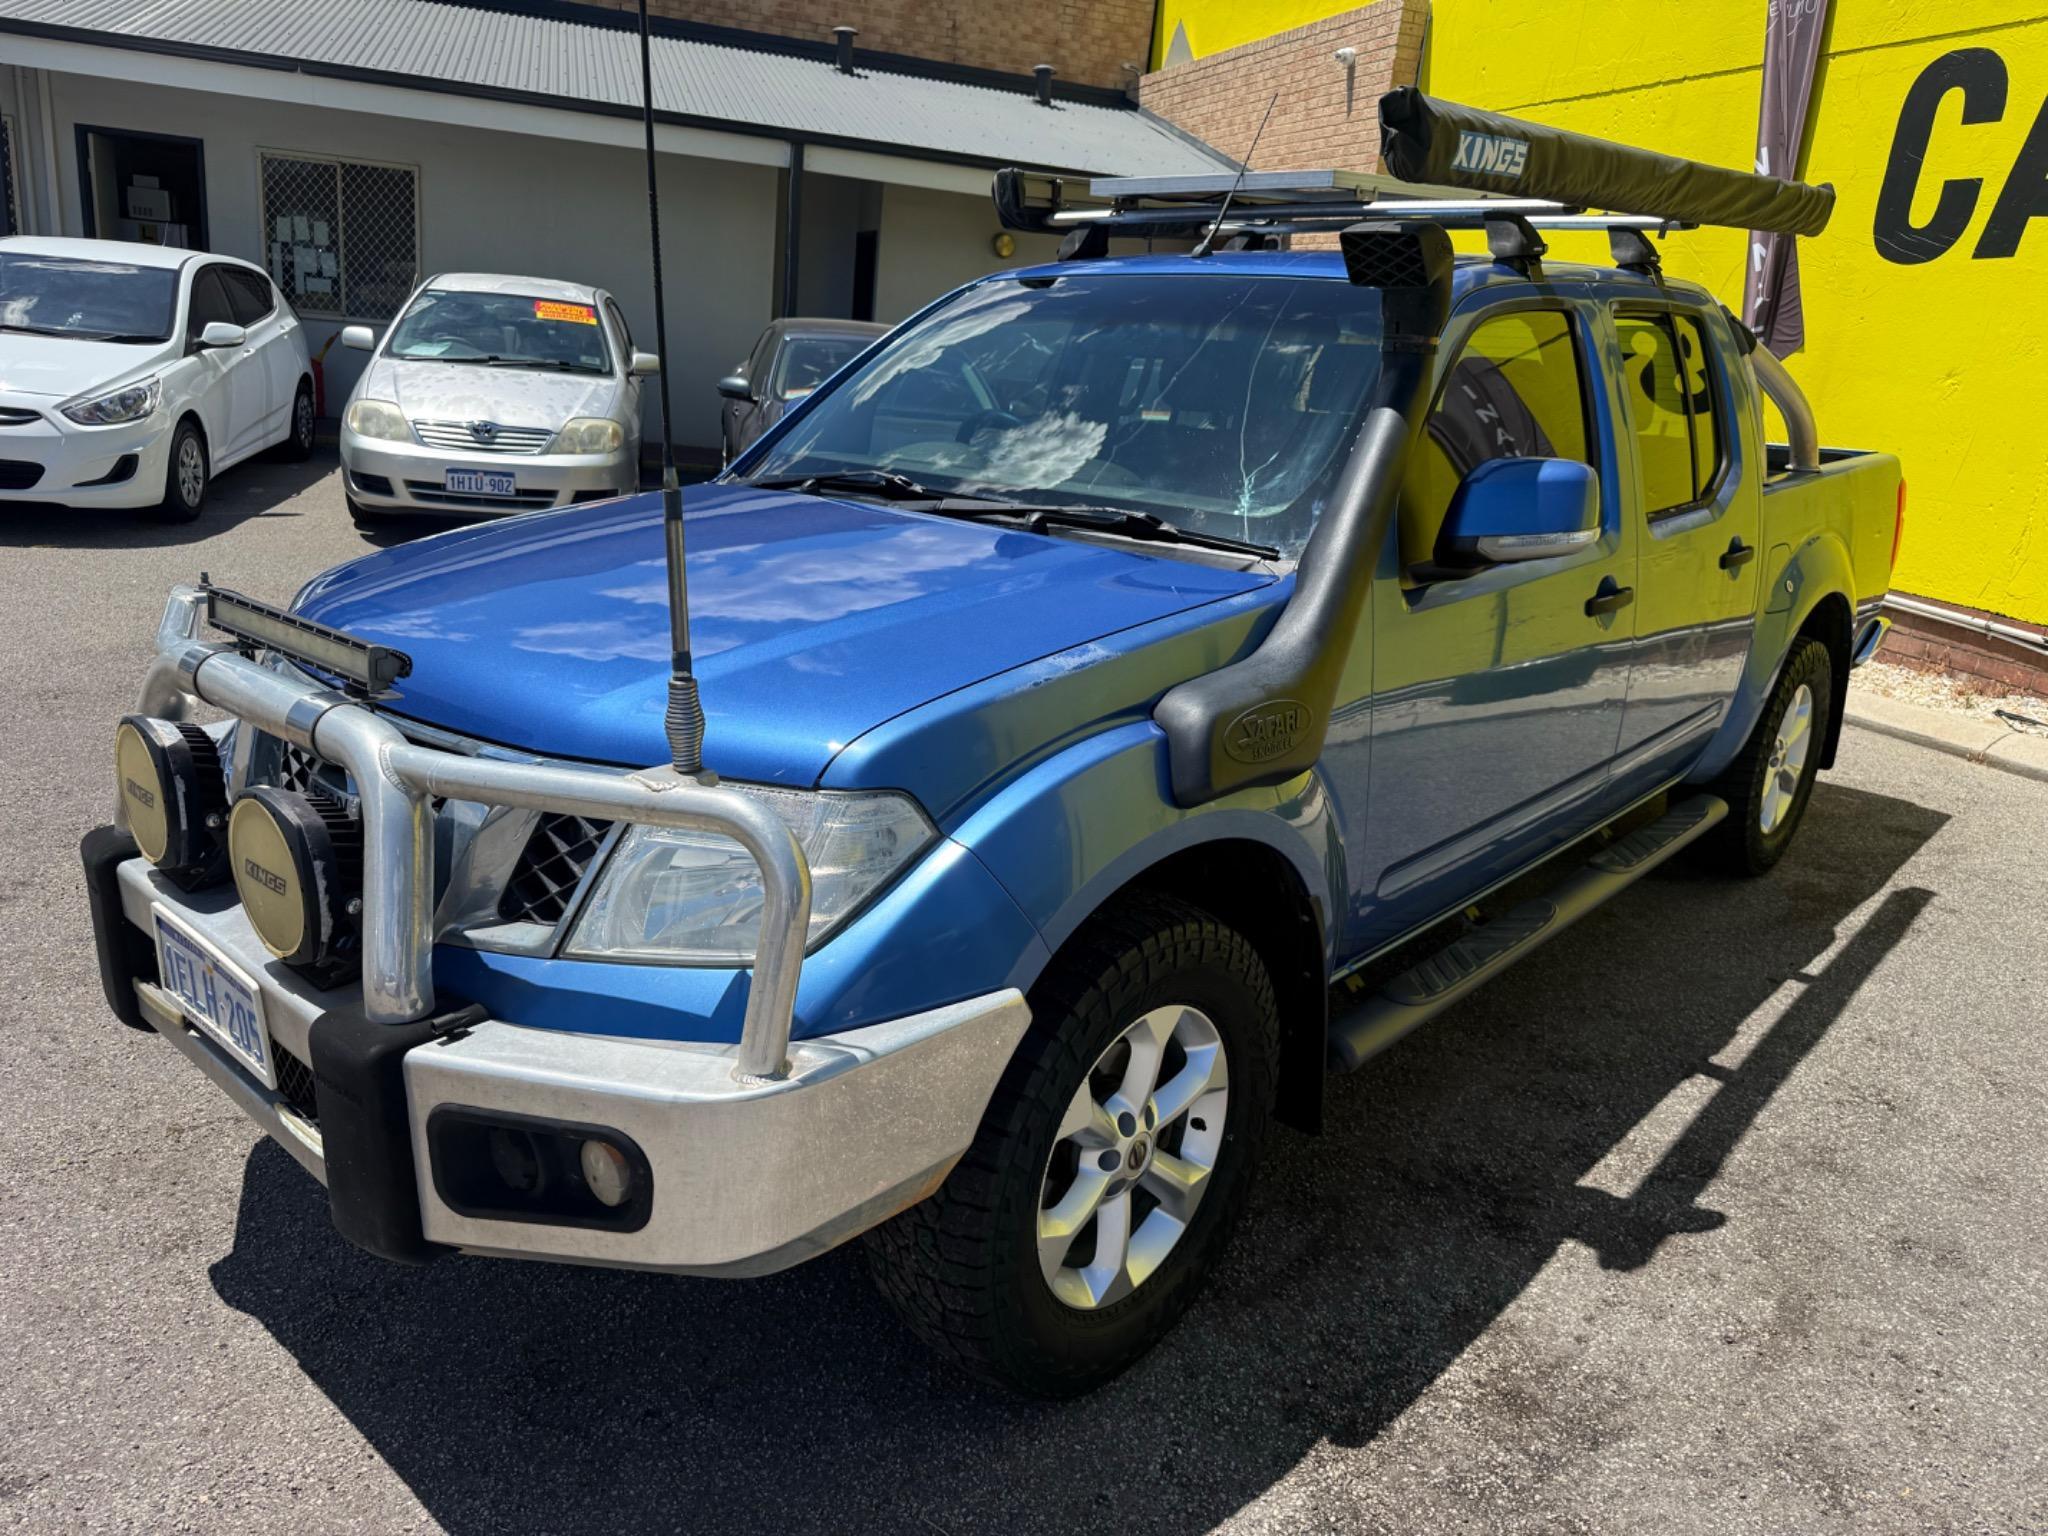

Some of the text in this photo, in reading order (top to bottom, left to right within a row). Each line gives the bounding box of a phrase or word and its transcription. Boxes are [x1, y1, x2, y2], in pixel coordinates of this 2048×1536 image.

[1451, 134, 1529, 176] KINGS
[127, 778, 154, 808] KINGS
[246, 859, 286, 896] KINGS
